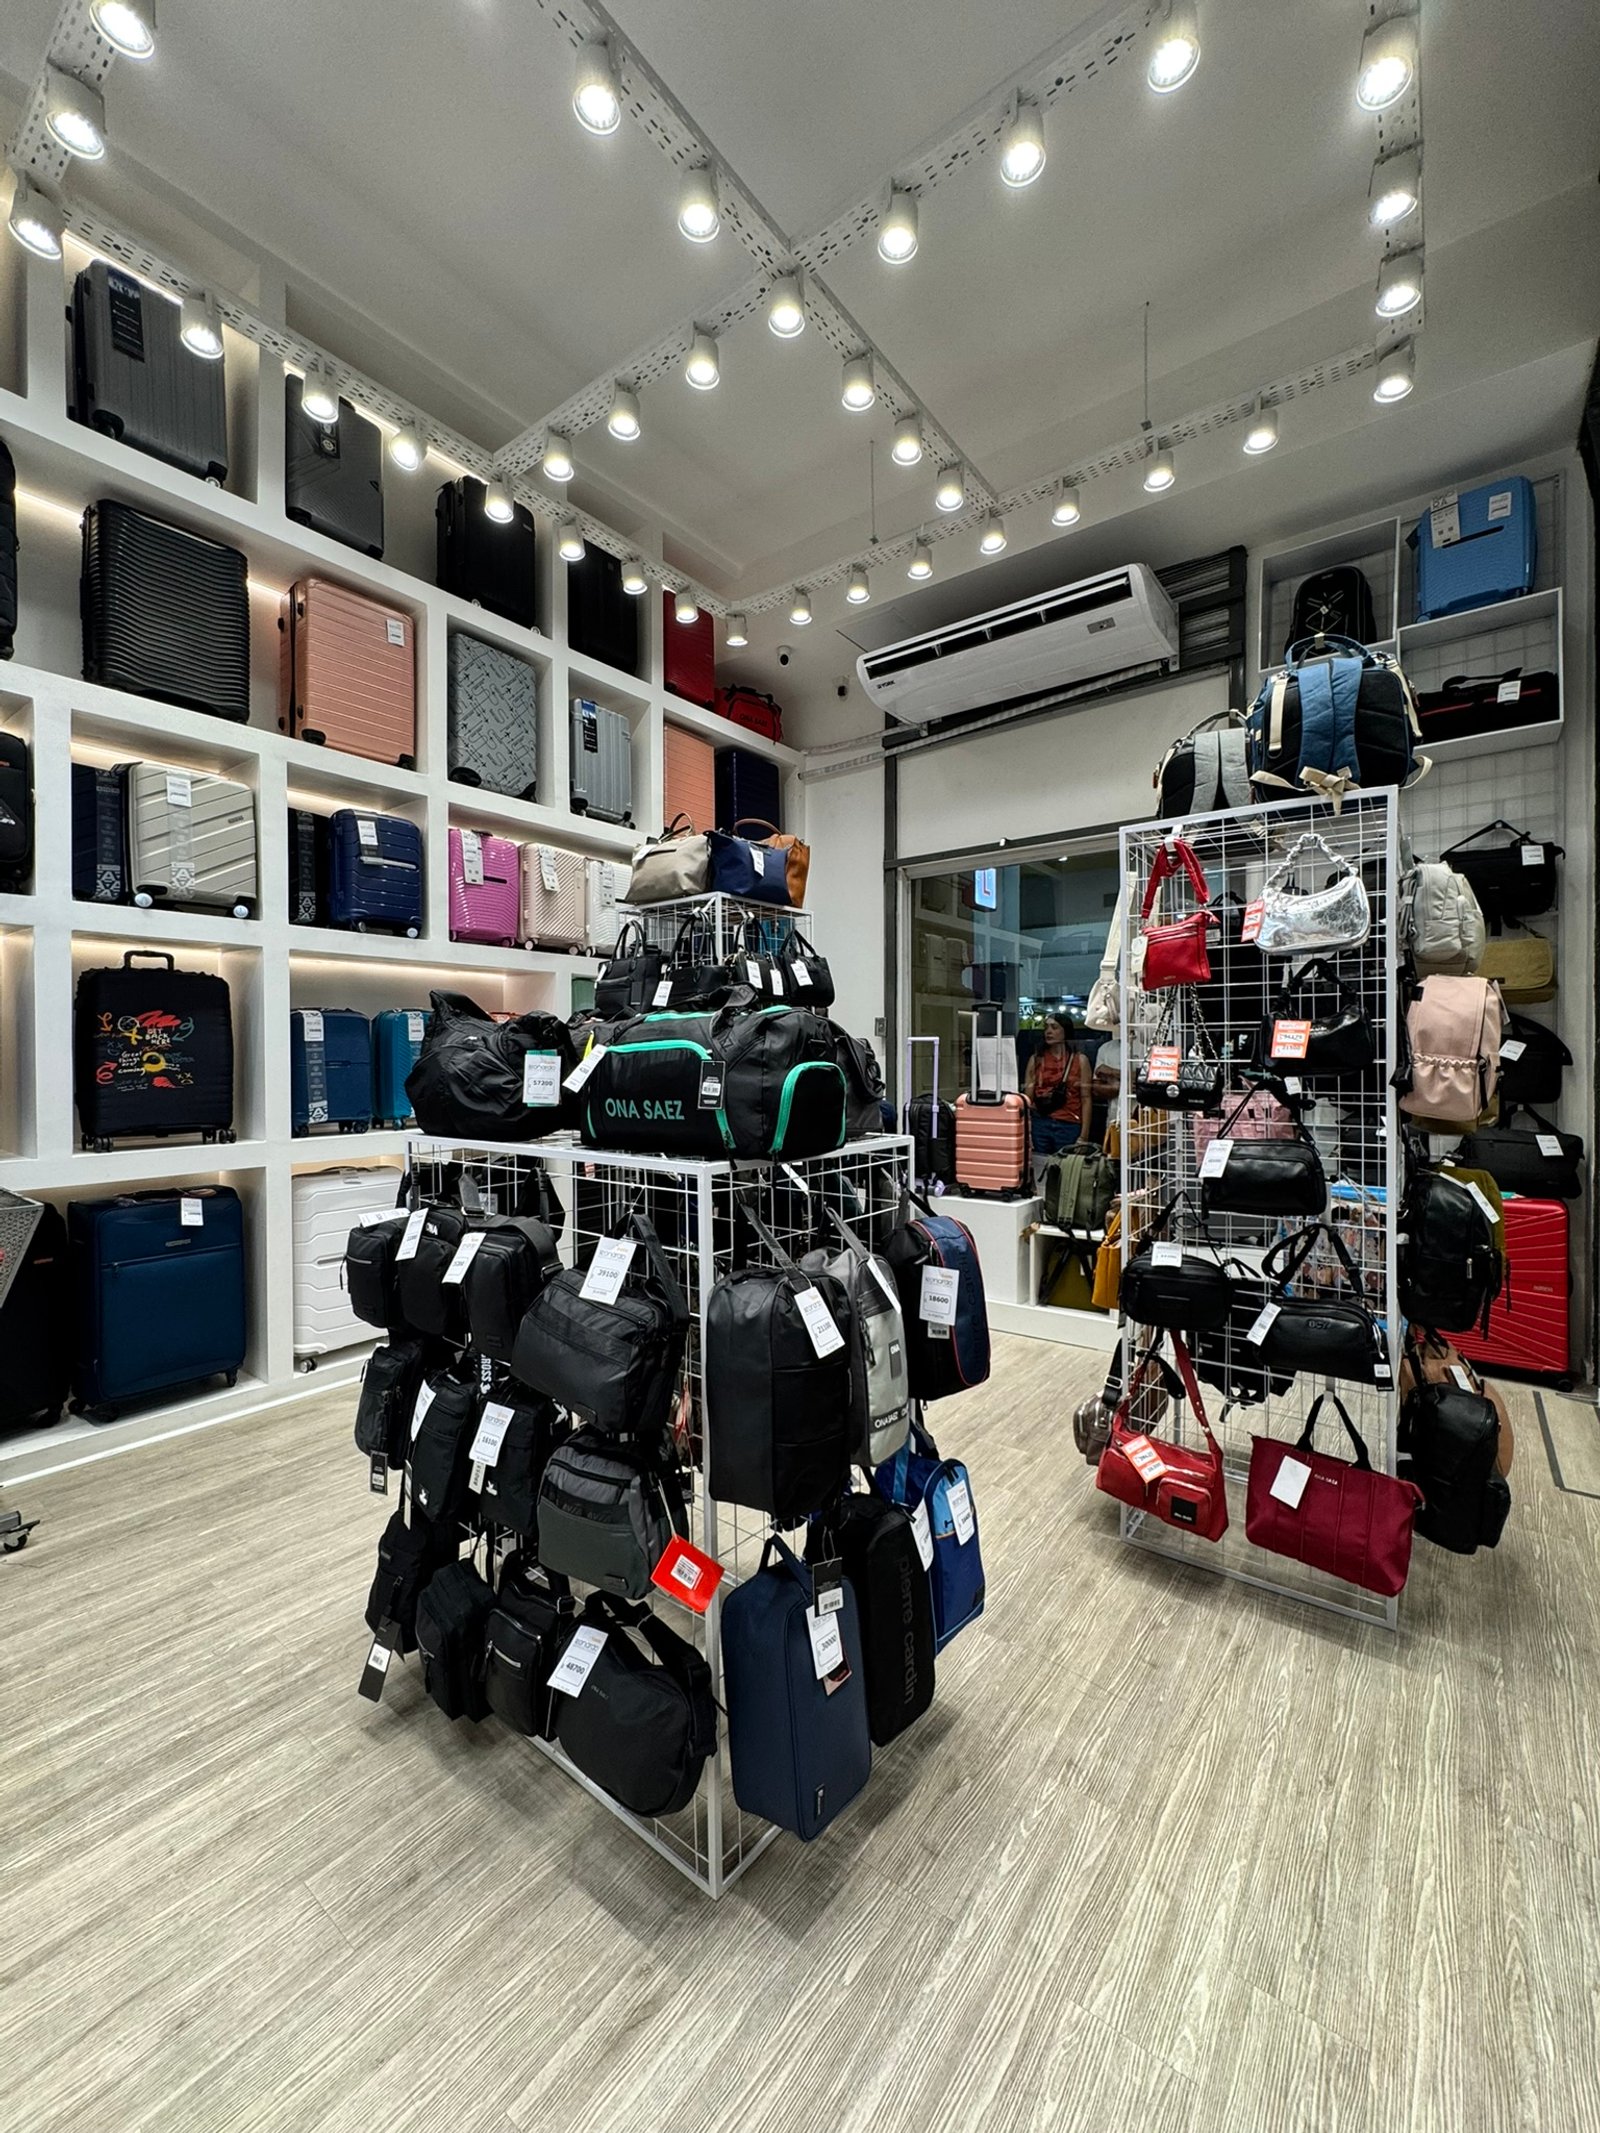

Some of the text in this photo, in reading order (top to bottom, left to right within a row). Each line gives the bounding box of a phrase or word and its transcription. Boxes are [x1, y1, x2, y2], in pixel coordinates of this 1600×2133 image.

[118, 1066, 146, 1076] coming
[605, 1098, 685, 1120] ONA SAEZ
[929, 1294, 949, 1304] 18600
[897, 1555, 917, 1704] pierre cardin
[566, 1661, 586, 1675] 48700
